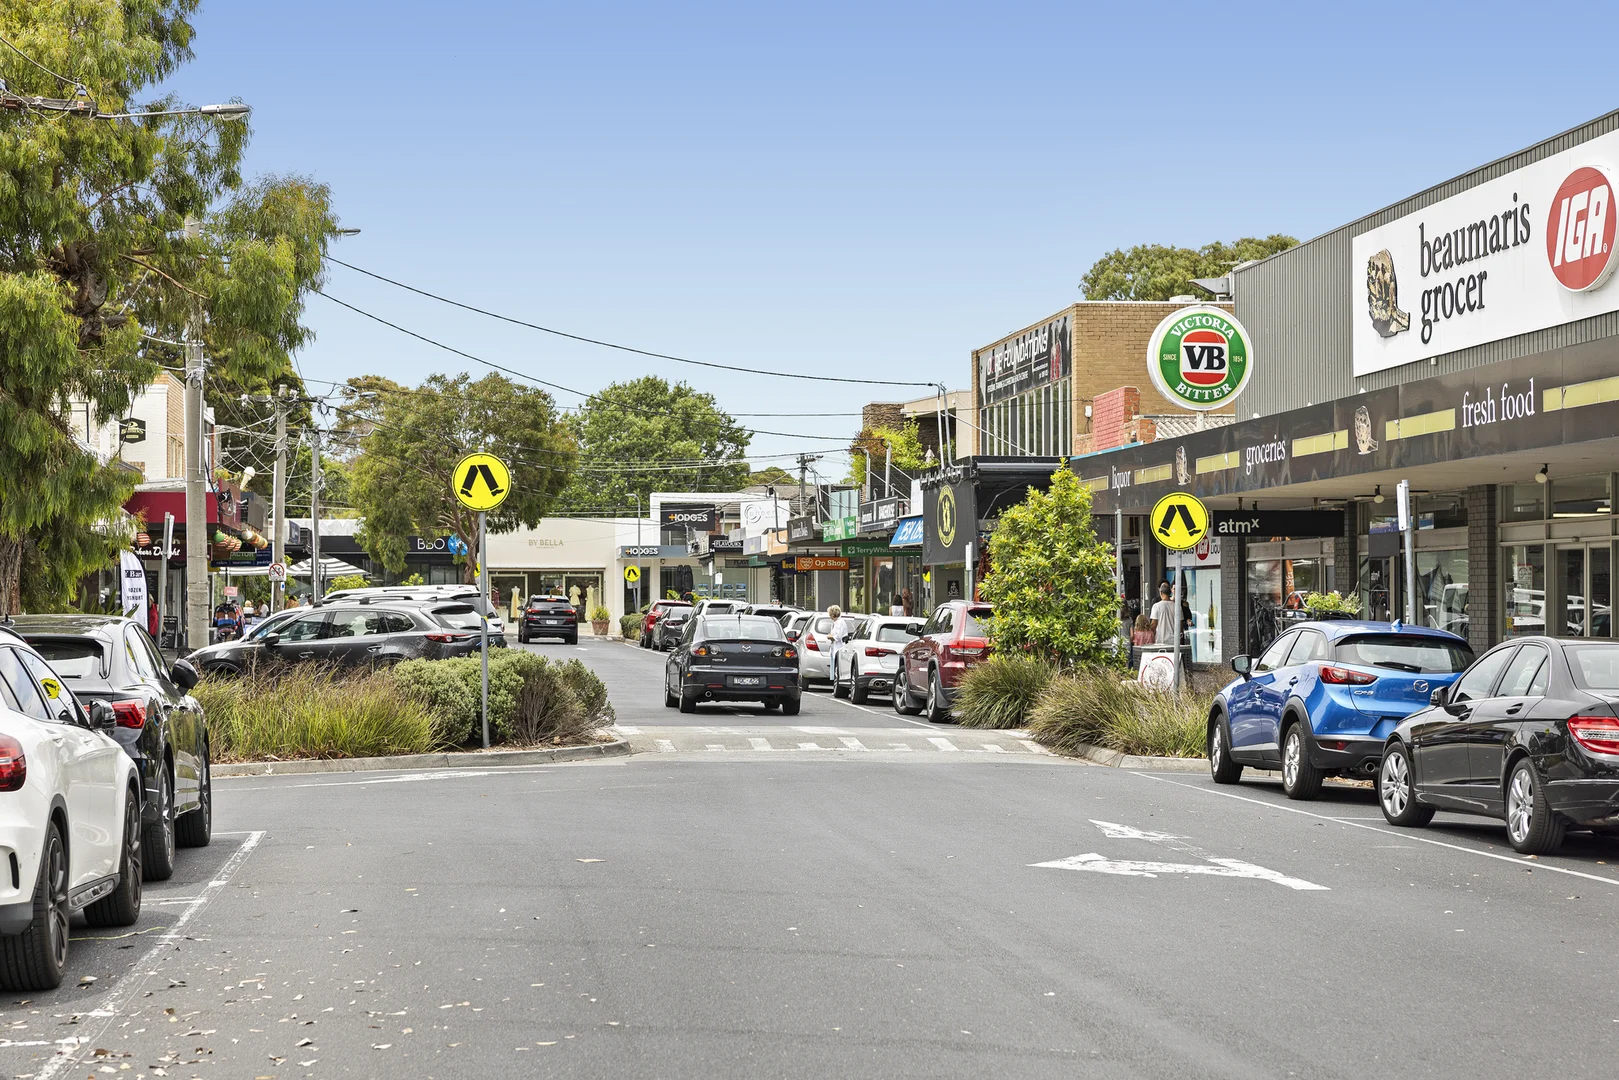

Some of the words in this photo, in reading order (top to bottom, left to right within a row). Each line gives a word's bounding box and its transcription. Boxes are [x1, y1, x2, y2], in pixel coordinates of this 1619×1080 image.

[1418, 192, 1531, 278] beaumaris
[1553, 184, 1609, 267] IGA
[1420, 270, 1488, 345] grocer
[1170, 315, 1235, 340] VICTORIA
[1003, 332, 1048, 369] FOUNDATIONS
[1162, 353, 1177, 361] SINCE
[1182, 345, 1226, 370] VB
[1232, 355, 1243, 363] 1854
[1175, 382, 1232, 400] BITTER
[1461, 391, 1497, 428] fresh
[1500, 378, 1536, 421] food
[1245, 434, 1286, 476] groceries
[1111, 465, 1131, 496] liquor
[668, 513, 708, 522] HODGES
[625, 547, 659, 555] HODGES
